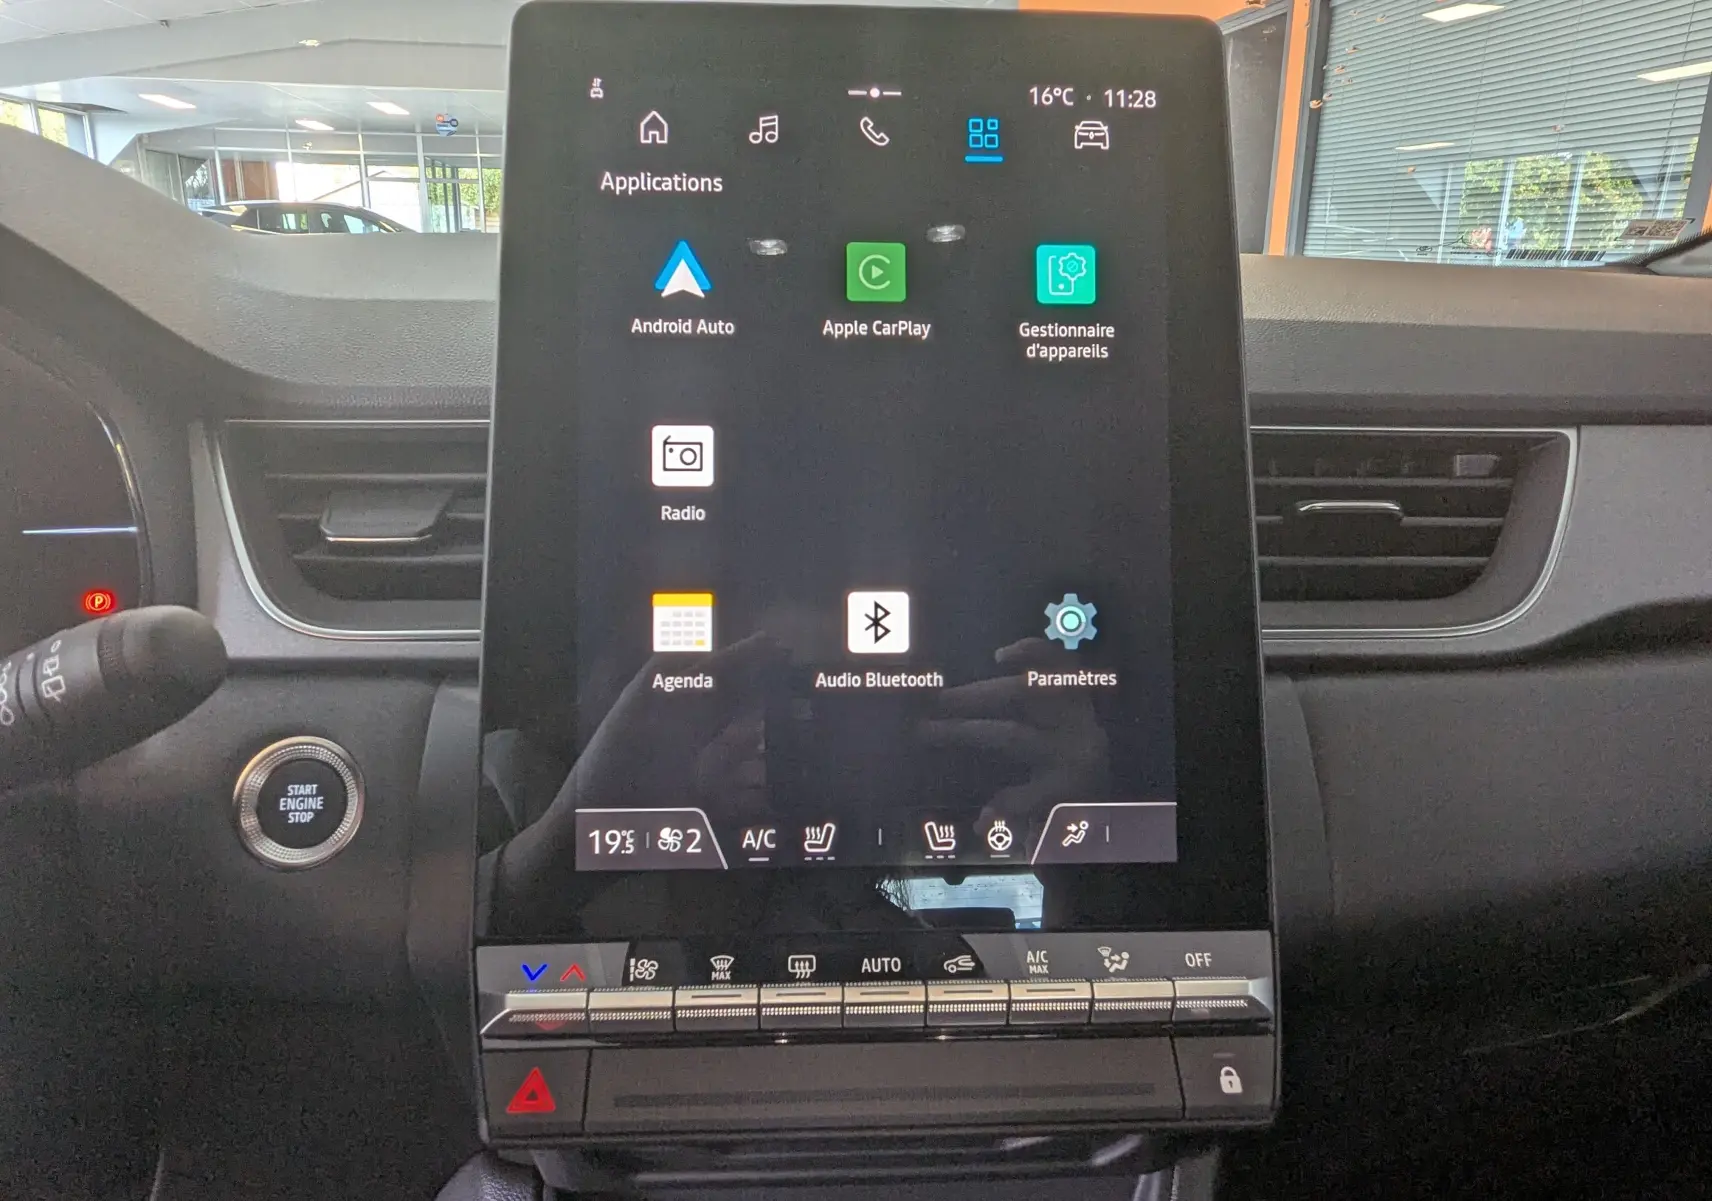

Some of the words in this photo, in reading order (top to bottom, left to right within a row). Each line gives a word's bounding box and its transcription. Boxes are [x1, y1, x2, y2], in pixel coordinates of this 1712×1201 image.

[1029, 86, 1074, 107] 16°C
[1104, 89, 1157, 109] 11:28
[600, 171, 723, 196] Applications
[631, 318, 692, 334] Android
[696, 319, 735, 335] Auto
[823, 320, 868, 339] Apple
[872, 320, 931, 340] CarPlay
[1019, 322, 1115, 339] Gestionnaire
[1026, 342, 1109, 361] d'appareils
[661, 505, 706, 521] Radio
[652, 673, 713, 693] Agenda
[815, 672, 861, 688] Audio
[865, 671, 944, 688] Bluetooth
[1027, 670, 1117, 687] Paramètres
[287, 784, 318, 796] START
[279, 797, 324, 811] ENGINE
[287, 811, 315, 824] STOP
[685, 828, 702, 854] 2
[742, 828, 777, 850] A/C
[861, 957, 902, 974] AUTO
[1026, 950, 1049, 965] A/C
[1184, 952, 1213, 968] OFF
[711, 971, 732, 981] MAX
[1029, 964, 1050, 974] MAX
